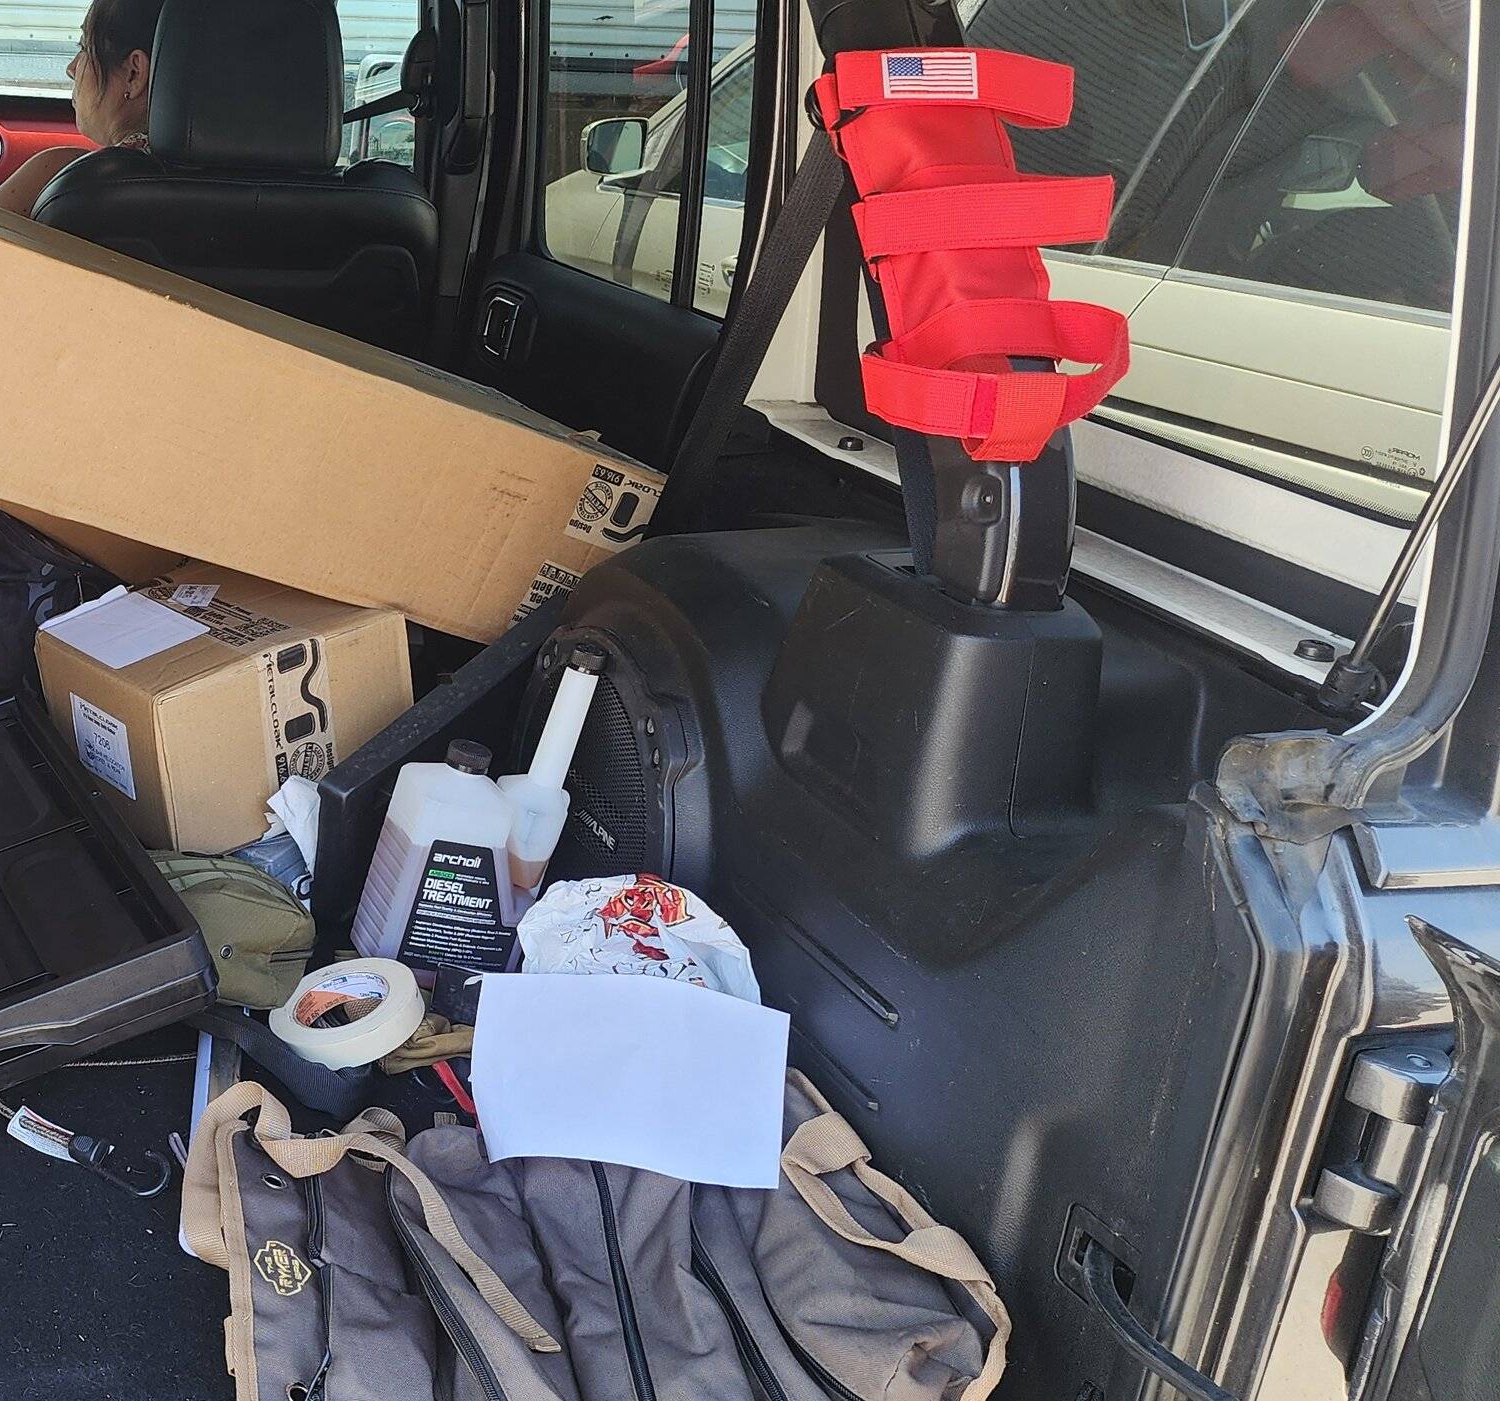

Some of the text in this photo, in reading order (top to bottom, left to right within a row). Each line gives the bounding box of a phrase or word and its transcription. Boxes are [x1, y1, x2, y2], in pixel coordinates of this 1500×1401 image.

[432, 852, 482, 869] archoil
[424, 877, 466, 895] DIESEL
[422, 889, 493, 910] TREATMENT
